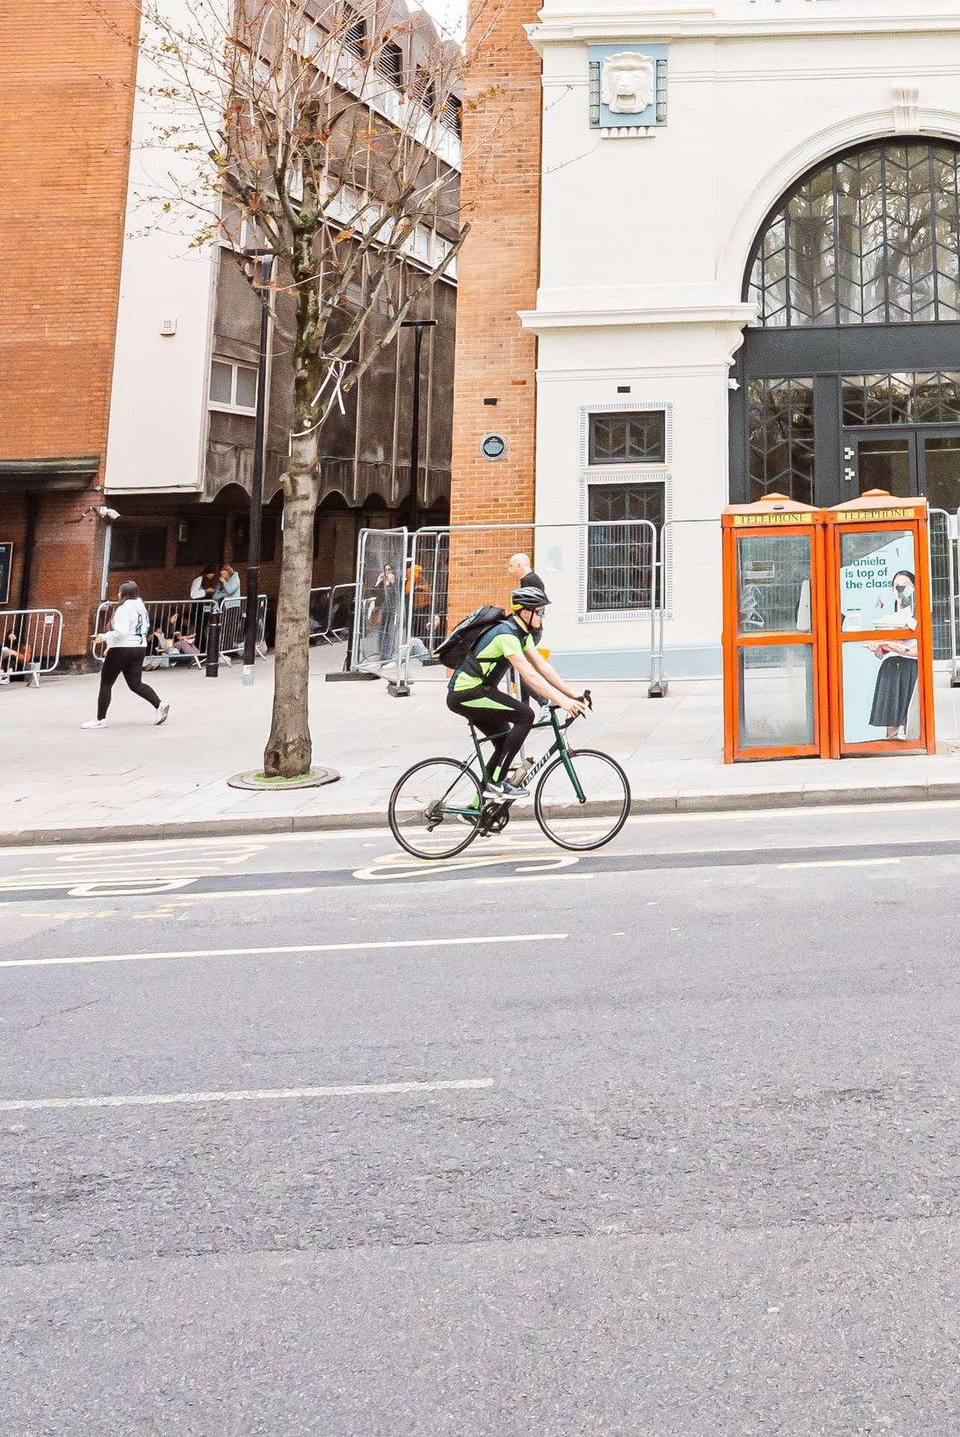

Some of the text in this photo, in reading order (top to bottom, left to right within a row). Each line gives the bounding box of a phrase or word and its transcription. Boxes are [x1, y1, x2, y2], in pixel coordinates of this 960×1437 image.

[741, 514, 805, 523] TELEPHONE
[844, 509, 909, 519] TELEPHONE
[846, 557, 886, 566] aniela
[845, 567, 888, 580] is top of
[845, 579, 893, 590] the class
